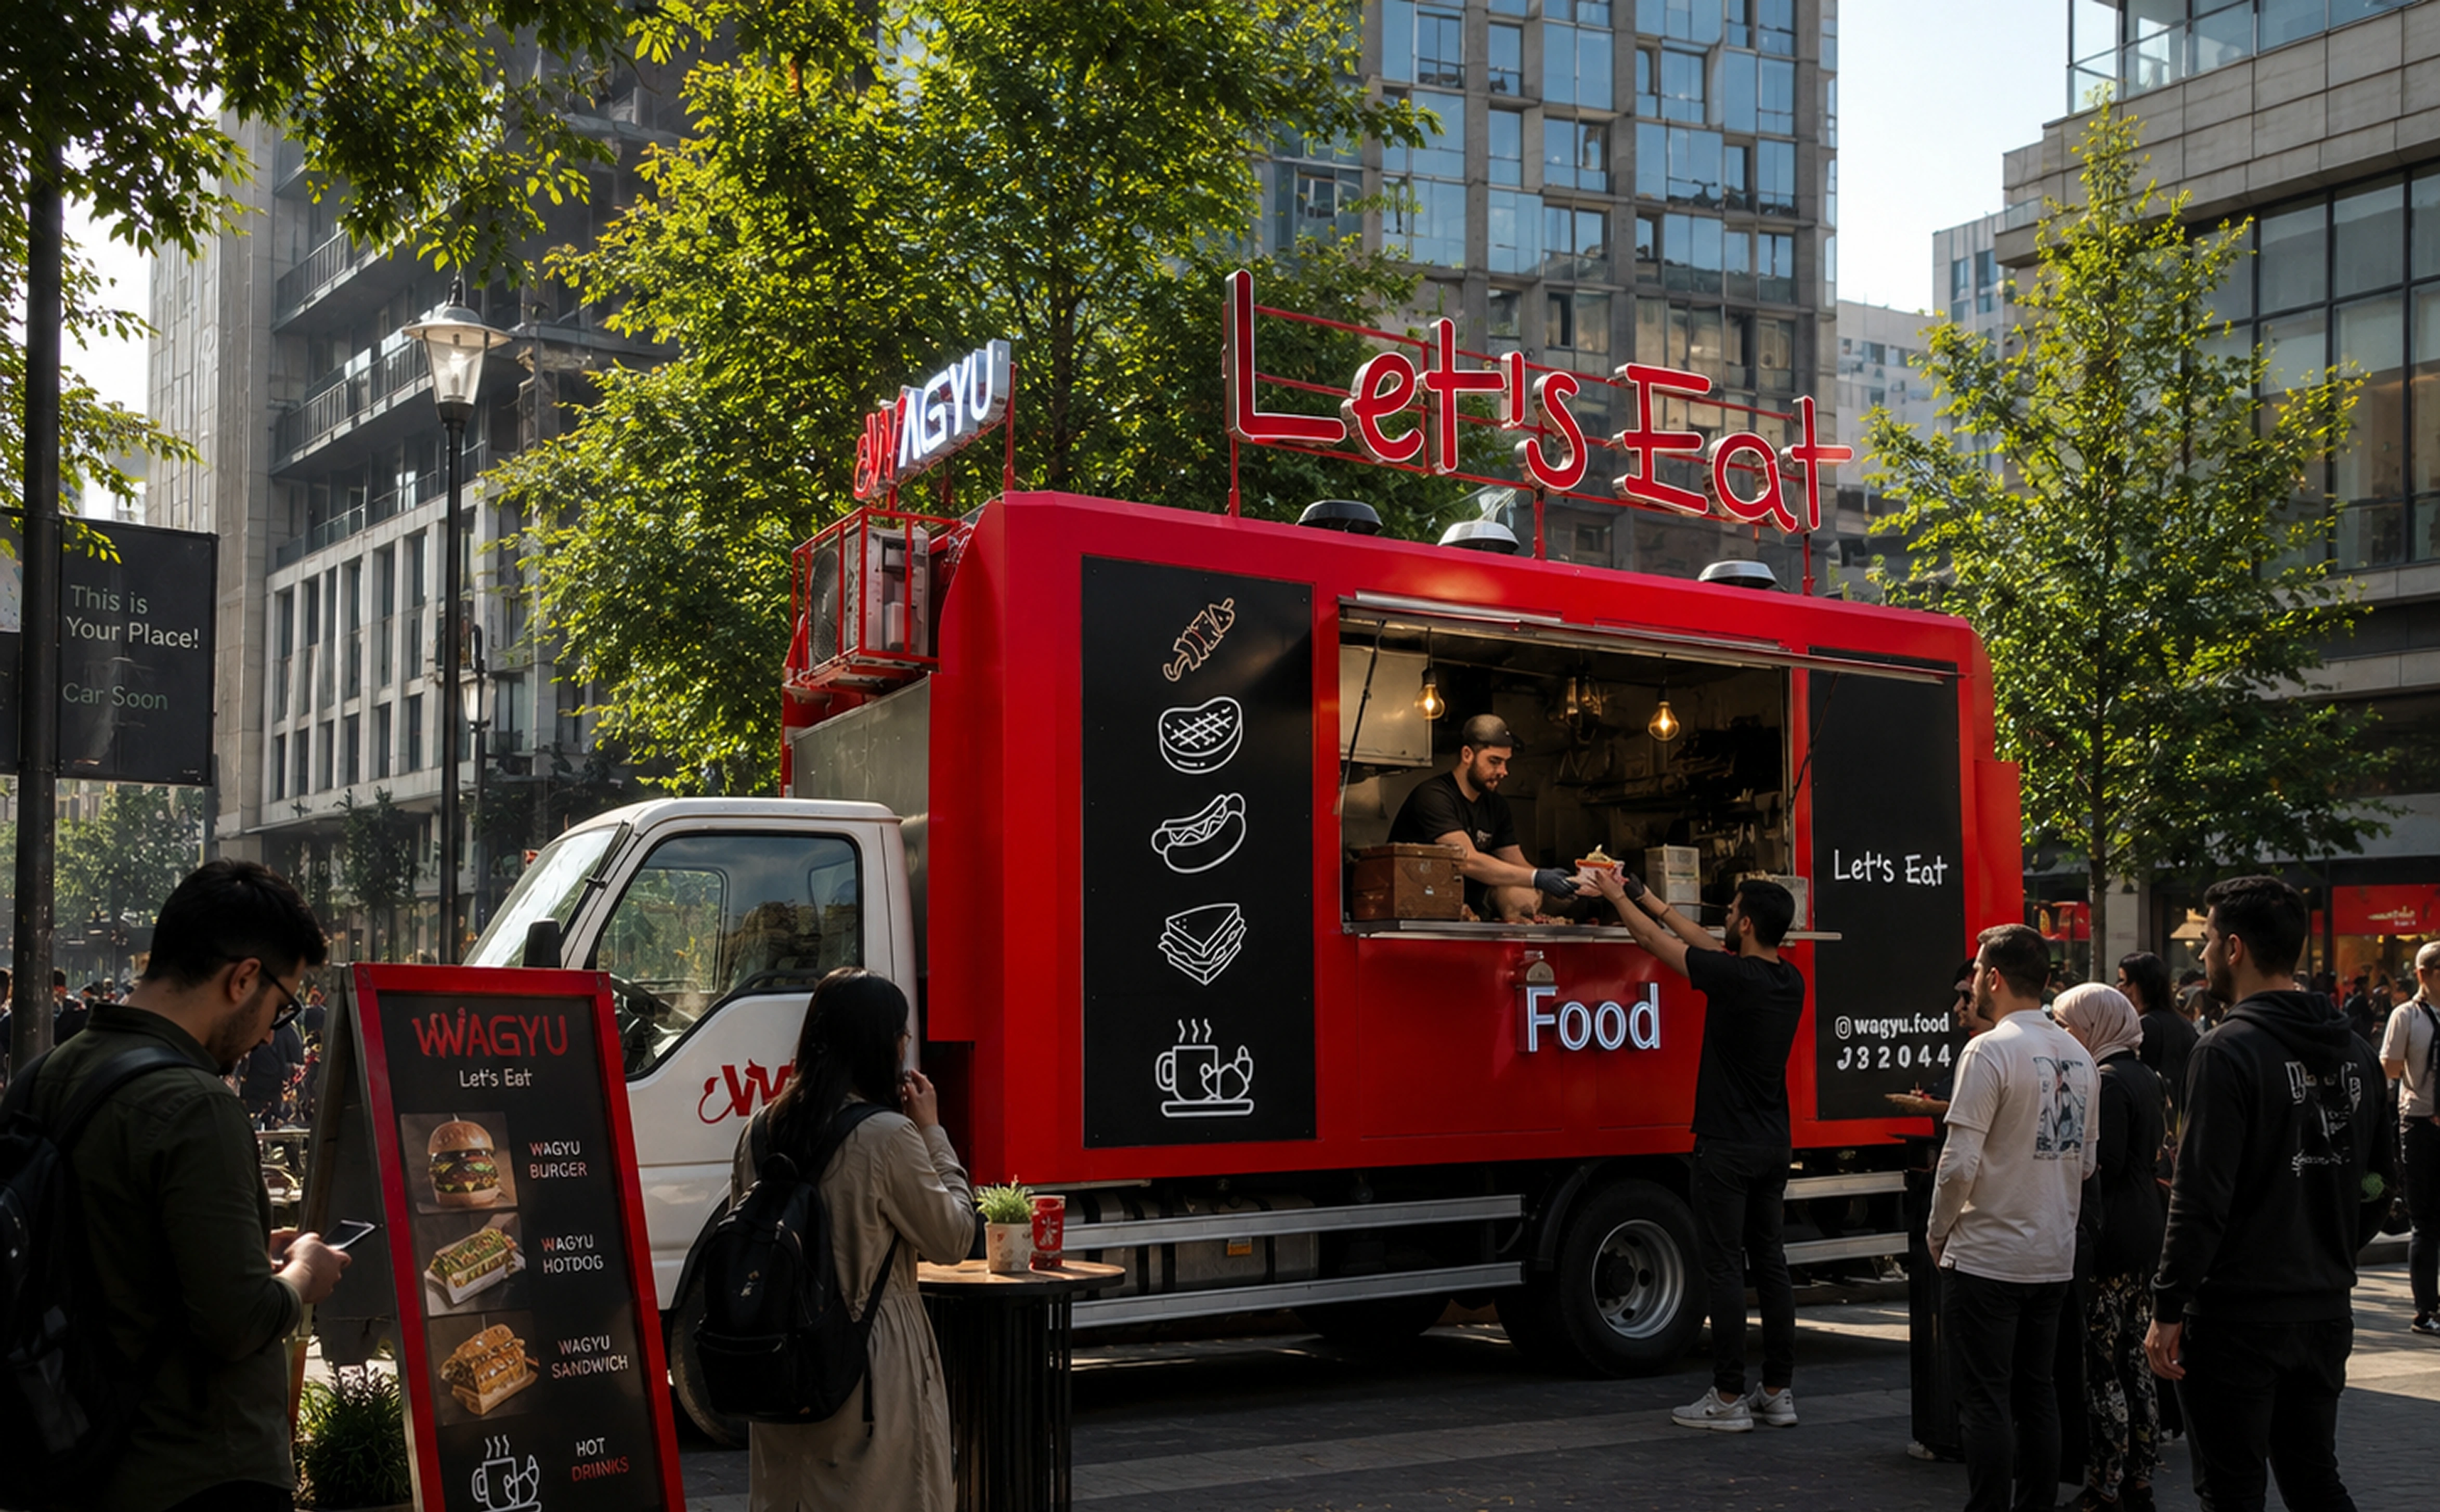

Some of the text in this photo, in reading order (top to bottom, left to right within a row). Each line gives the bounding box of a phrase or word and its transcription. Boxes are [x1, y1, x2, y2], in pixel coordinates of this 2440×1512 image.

[1226, 268, 1854, 533] Let's Eat
[70, 584, 148, 615] This is
[66, 616, 199, 649] Your Place!
[62, 682, 167, 711] Car Soon
[1834, 849, 1948, 886] Let's Eat
[1525, 982, 1660, 1052] Food
[459, 1068, 532, 1087] Let's Eat
[529, 1141, 580, 1156] WAGYU
[529, 1162, 587, 1178] BURGER
[541, 1234, 593, 1252] WAGYU
[543, 1255, 603, 1273] HOTDOG
[557, 1335, 610, 1355] WAGYU
[552, 1355, 628, 1379] SANDWICH
[576, 1437, 605, 1457] HOT
